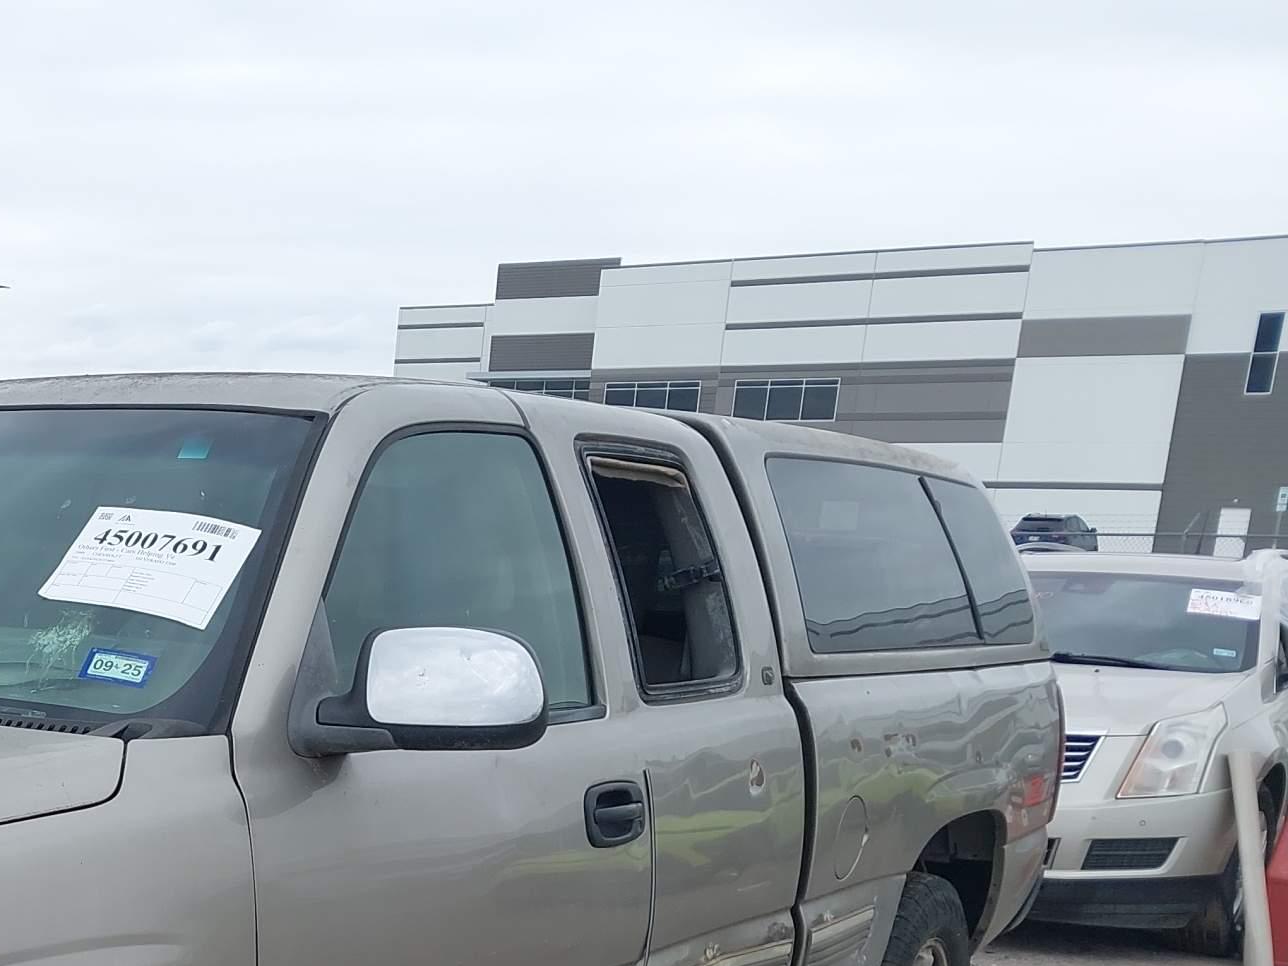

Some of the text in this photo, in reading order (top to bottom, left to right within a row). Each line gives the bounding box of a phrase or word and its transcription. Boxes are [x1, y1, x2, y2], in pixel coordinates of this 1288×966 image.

[94, 528, 223, 562] 45007691
[93, 659, 143, 677] 09 25
